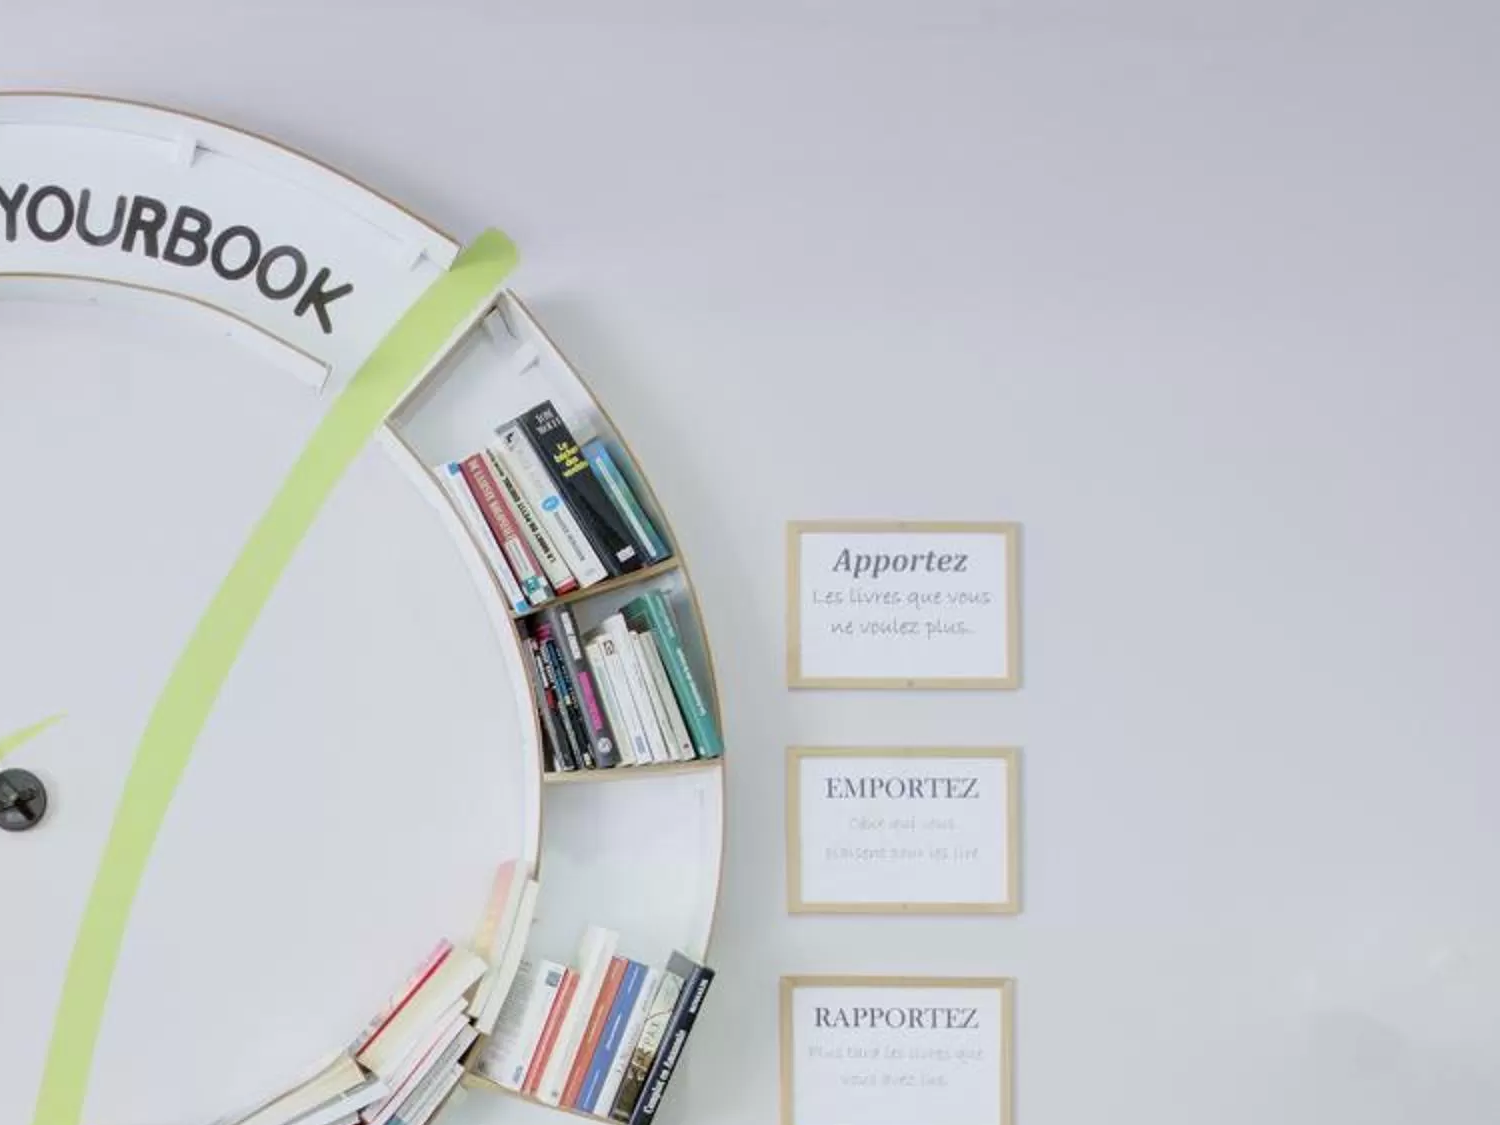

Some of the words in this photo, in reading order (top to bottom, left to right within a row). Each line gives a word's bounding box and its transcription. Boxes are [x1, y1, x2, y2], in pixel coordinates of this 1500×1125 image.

[832, 547, 969, 579] Apportez
[812, 589, 843, 605] Les
[906, 591, 942, 611] que
[947, 591, 992, 605] vous
[830, 620, 854, 635] ne
[859, 616, 920, 635] voulez
[825, 776, 980, 800] EMPORTEZ
[814, 1006, 979, 1030] RAPPORTEZ
